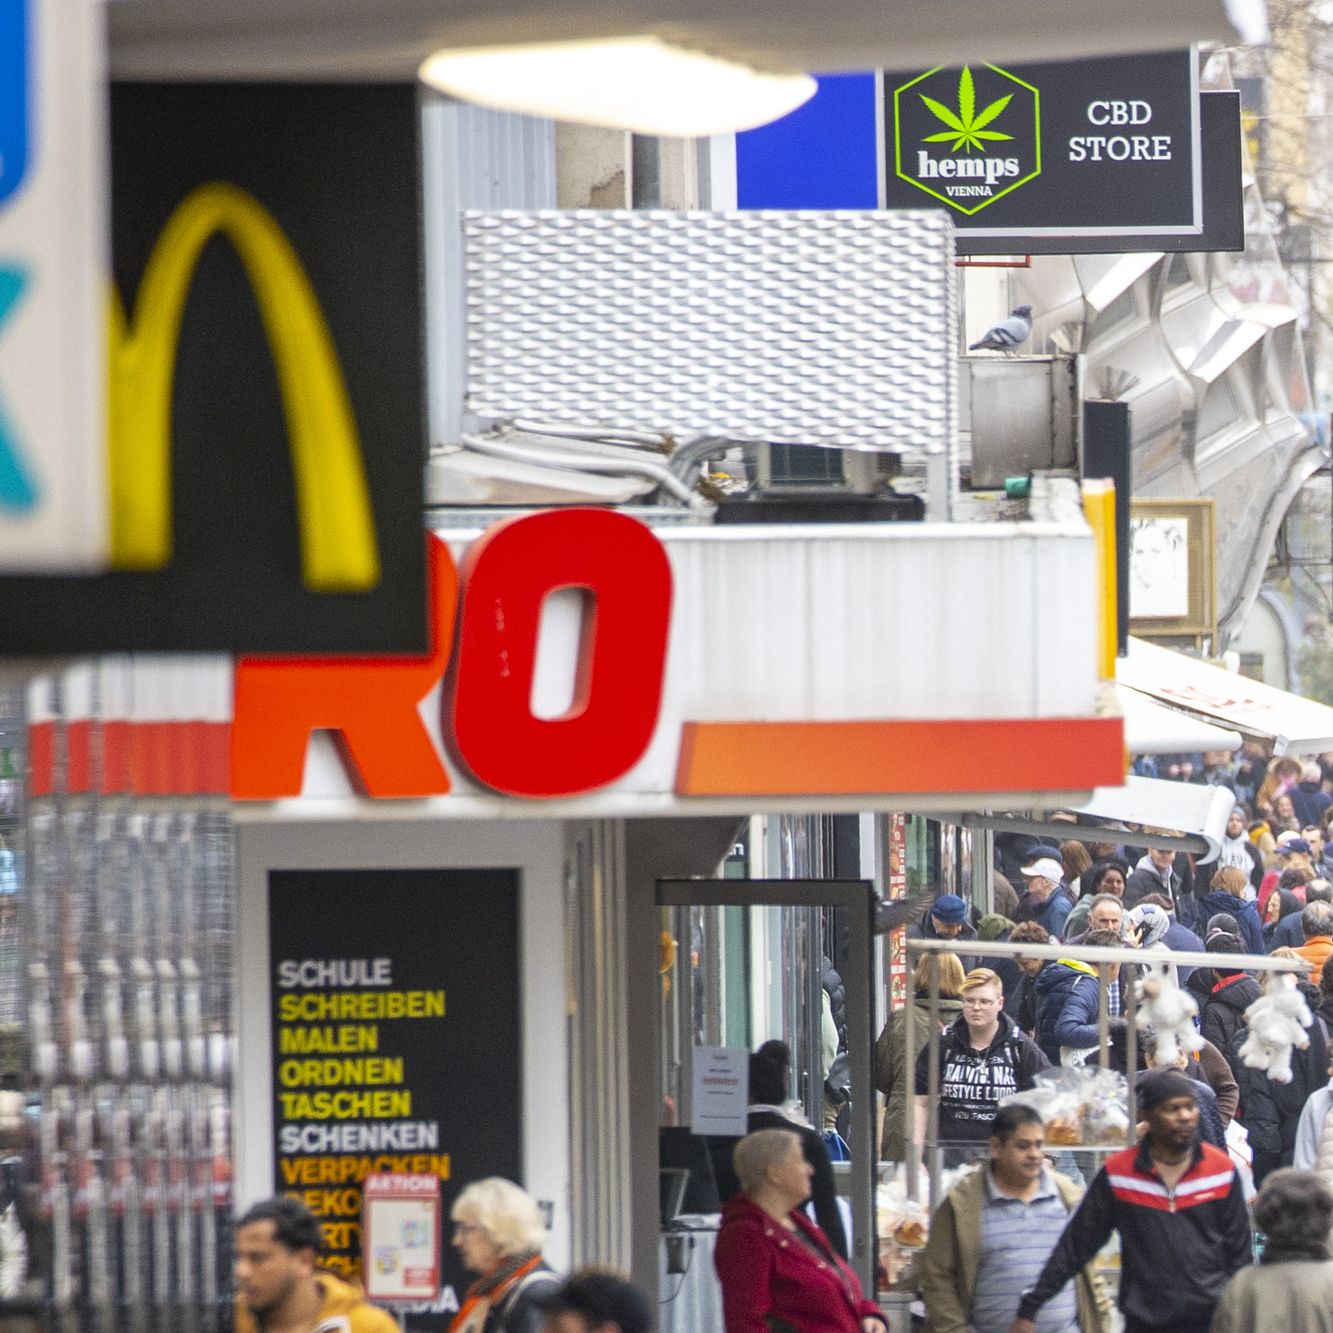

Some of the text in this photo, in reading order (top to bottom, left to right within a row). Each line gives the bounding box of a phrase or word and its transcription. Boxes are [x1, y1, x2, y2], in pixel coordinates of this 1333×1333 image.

[1087, 101, 1152, 125] CBD
[1069, 136, 1171, 161] STORE
[918, 151, 1019, 184] hemps
[946, 186, 993, 196] VIENNA
[278, 958, 392, 987] SCHULE
[279, 990, 445, 1021] SCHREIBEN
[280, 1024, 378, 1054] MALEN
[279, 1056, 404, 1087] ORDNEN
[280, 1090, 411, 1119] TASCHEN
[279, 1120, 439, 1153] SCHENKEN
[280, 1153, 450, 1185] VERPACKEN
[366, 1174, 438, 1191] AKTION
